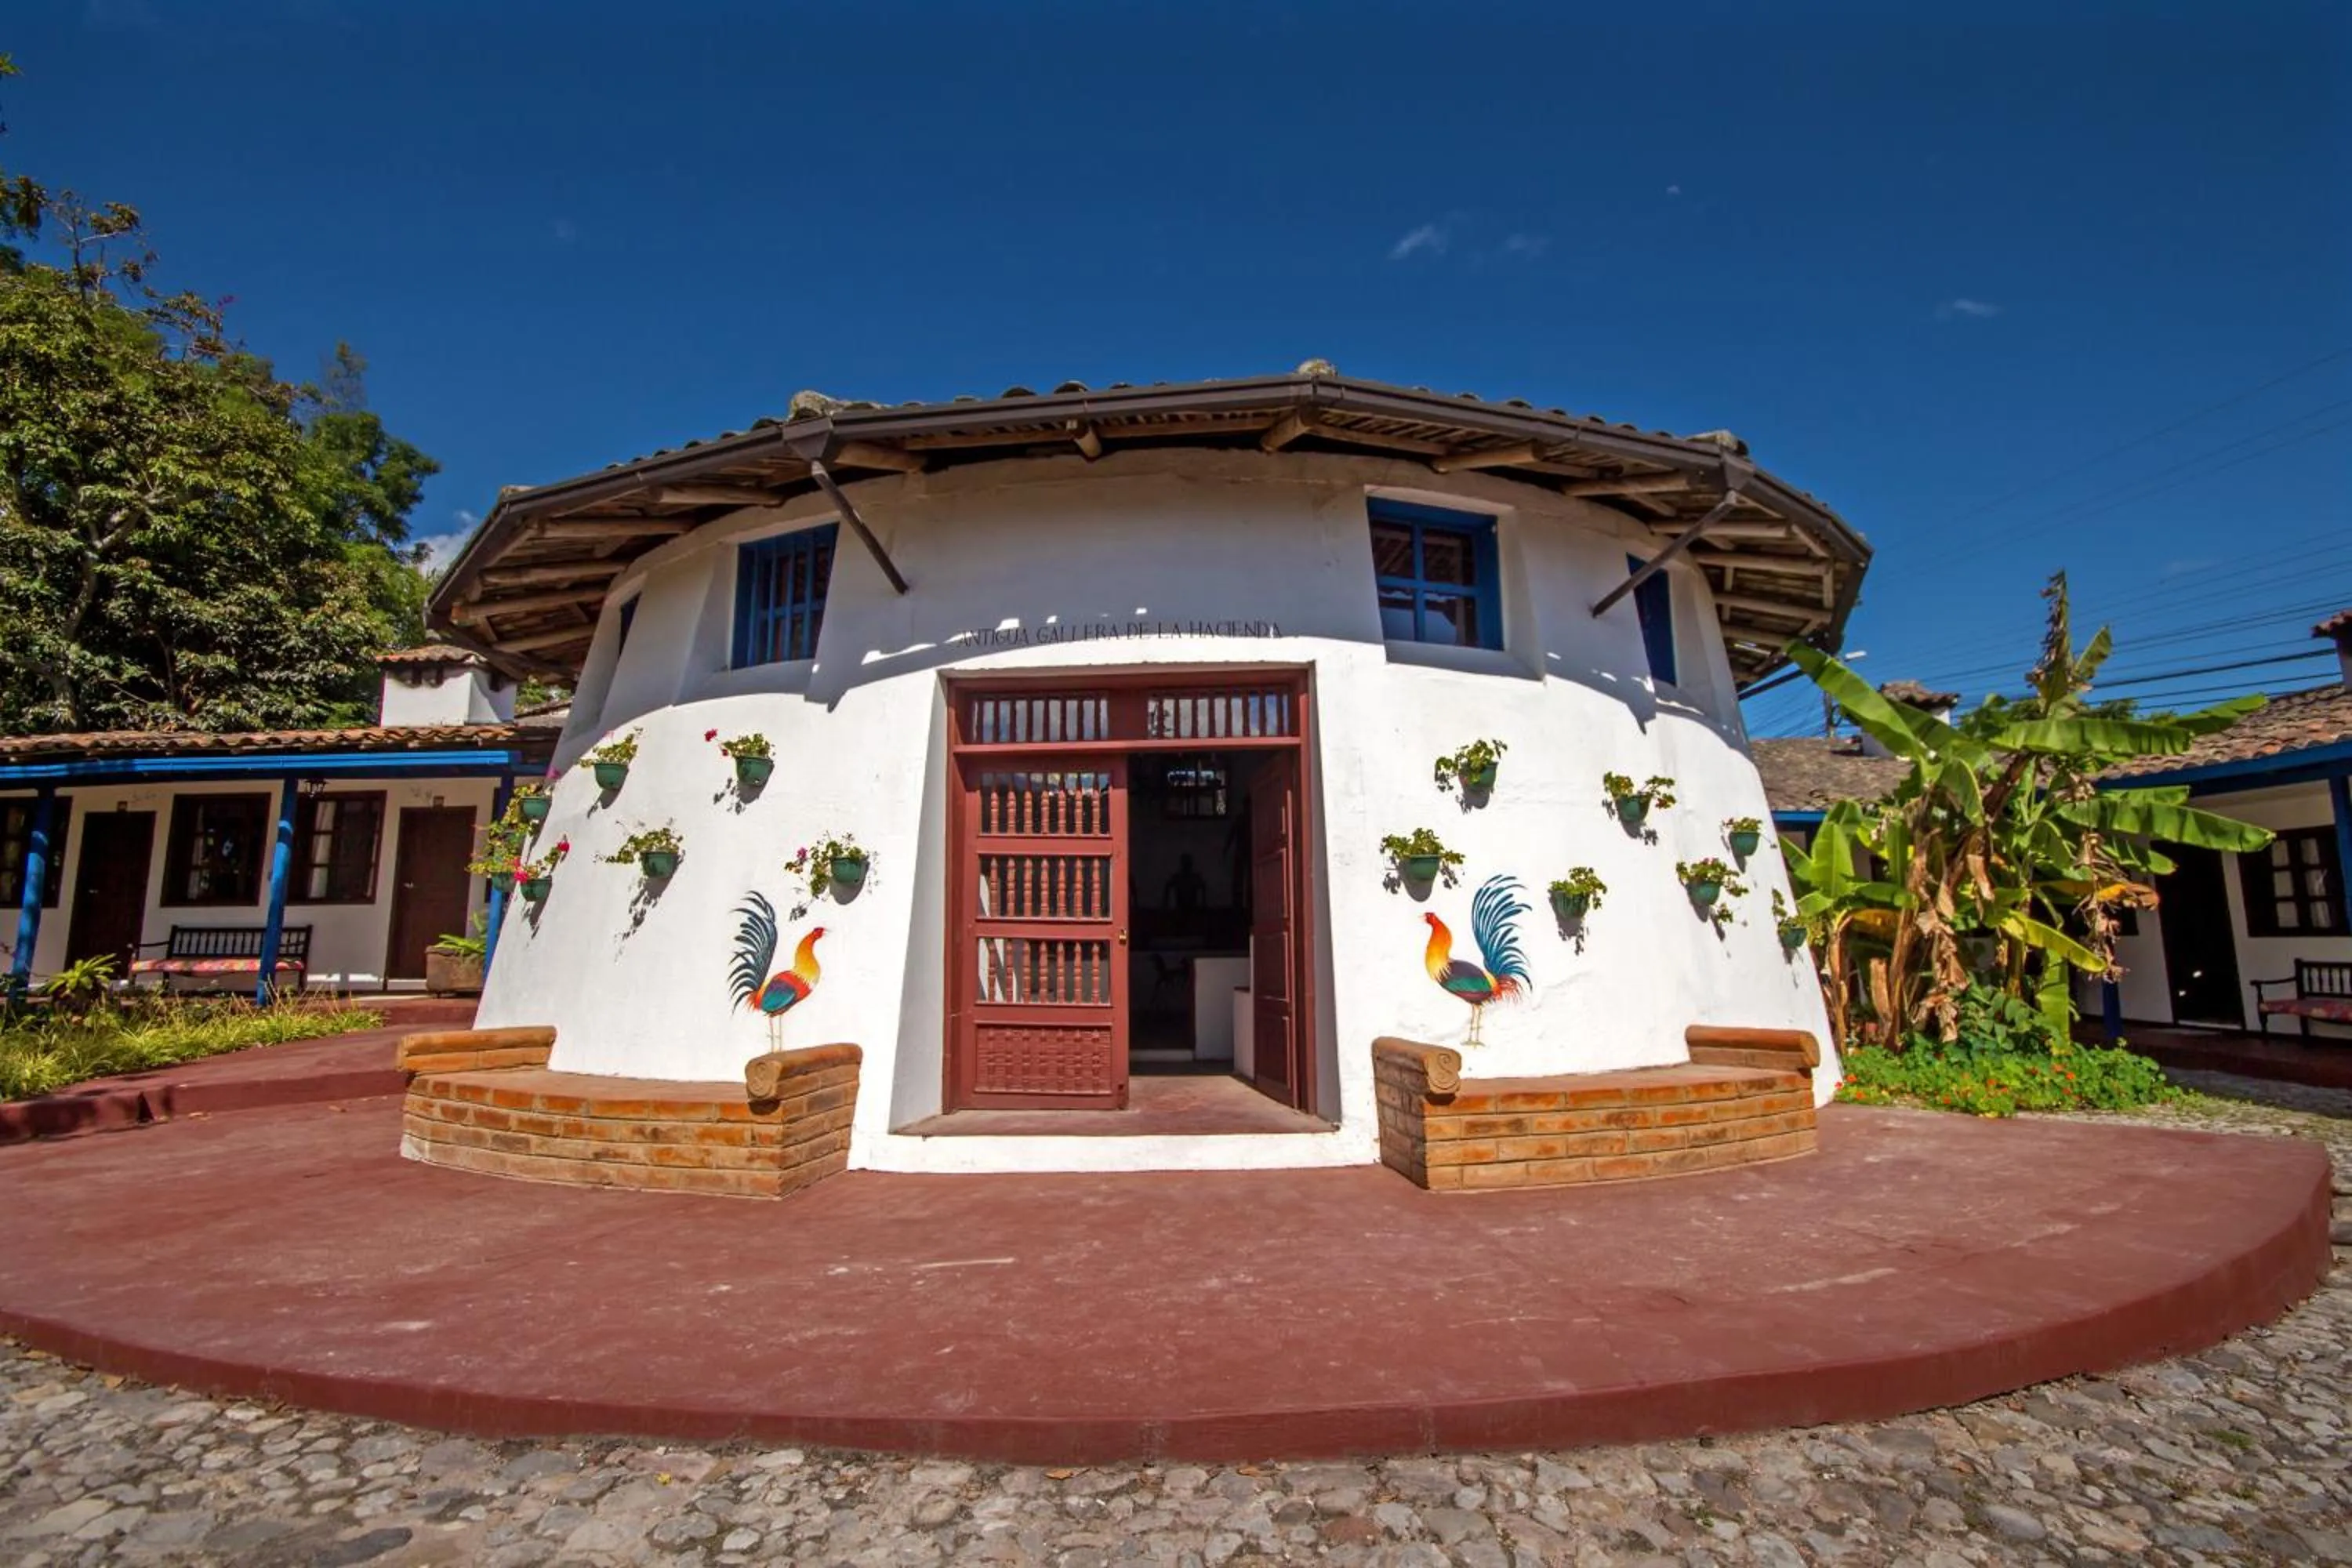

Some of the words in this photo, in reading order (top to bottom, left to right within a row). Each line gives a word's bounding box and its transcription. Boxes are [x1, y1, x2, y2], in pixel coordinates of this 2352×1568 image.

[1126, 621, 1149, 640] DE
[1158, 620, 1181, 639] LA
[1189, 619, 1283, 640] HACIENDA
